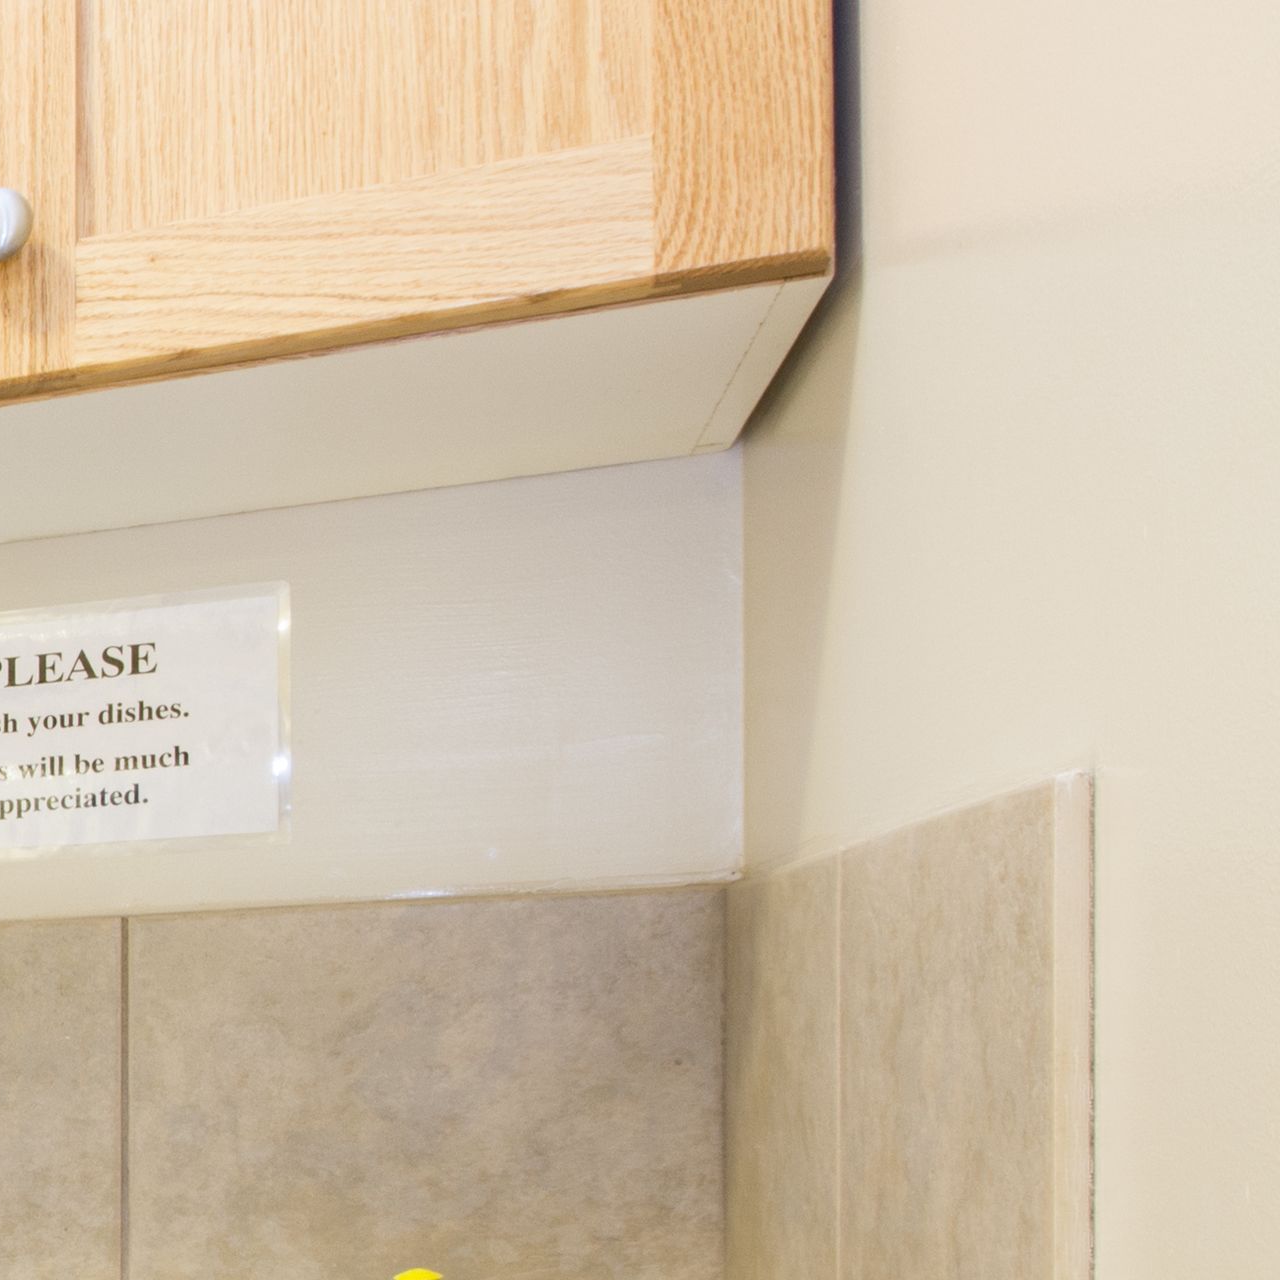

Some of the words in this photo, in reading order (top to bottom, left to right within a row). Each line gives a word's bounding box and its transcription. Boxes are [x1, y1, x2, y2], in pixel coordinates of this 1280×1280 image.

[27, 711, 90, 737] your
[98, 700, 190, 727] dishes.
[19, 755, 65, 780] will
[74, 753, 104, 775] be
[114, 745, 191, 772] much
